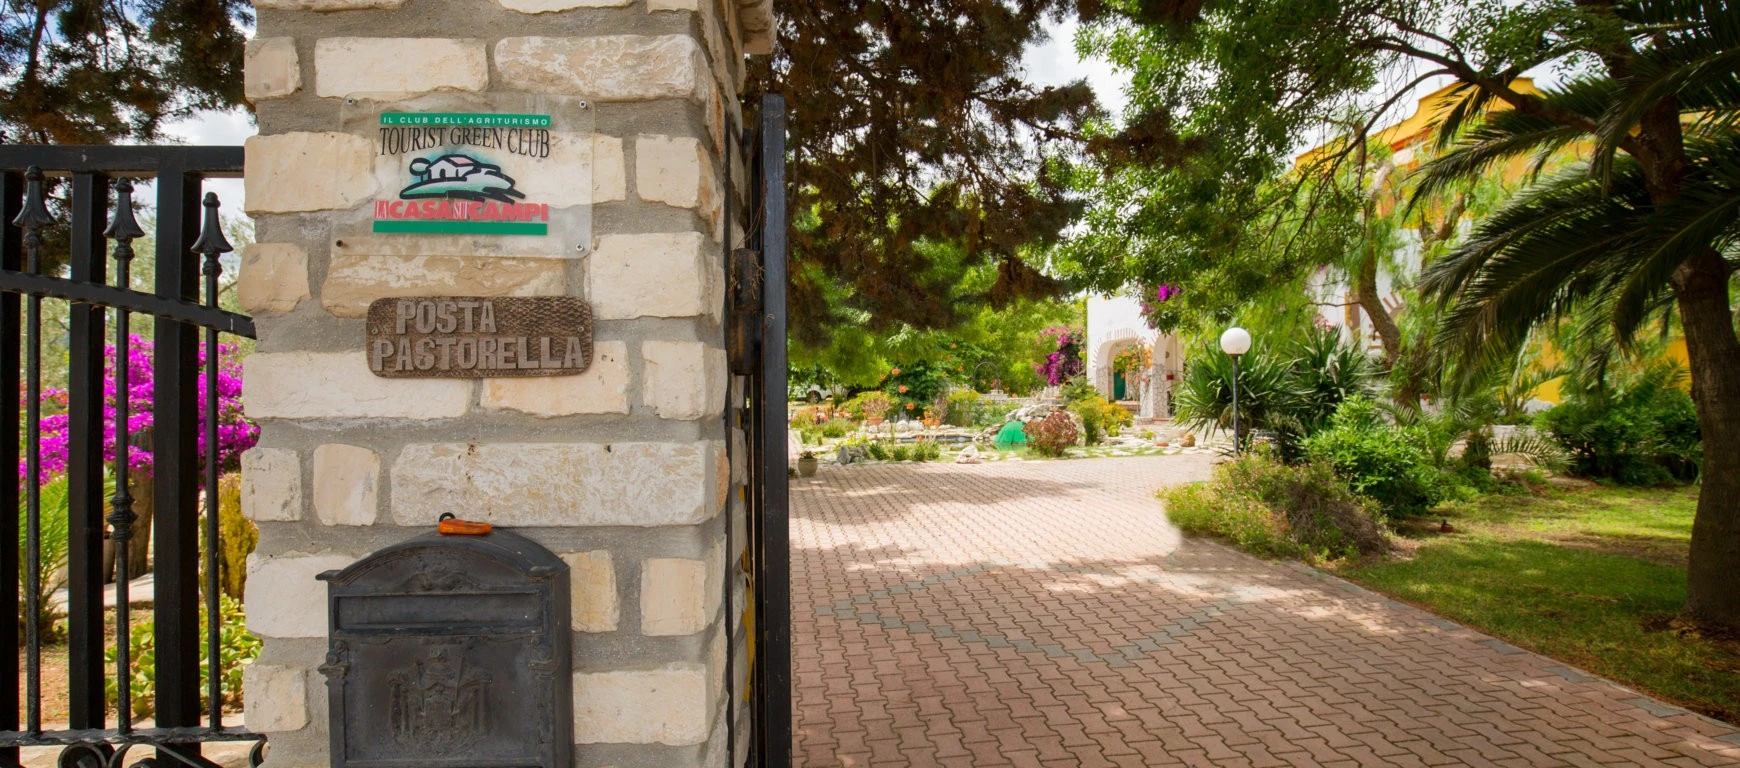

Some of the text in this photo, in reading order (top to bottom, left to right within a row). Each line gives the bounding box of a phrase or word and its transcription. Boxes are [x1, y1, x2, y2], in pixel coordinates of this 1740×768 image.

[383, 116, 548, 126] IL CLUB DELL'AGRITURISMO
[380, 126, 550, 159] TOURIST GREEN CLUB
[374, 201, 388, 219] LA
[389, 200, 452, 219] CASA
[468, 201, 549, 222] CAMPI
[396, 300, 497, 335] POSTA
[371, 336, 585, 372] PASTORELLA
